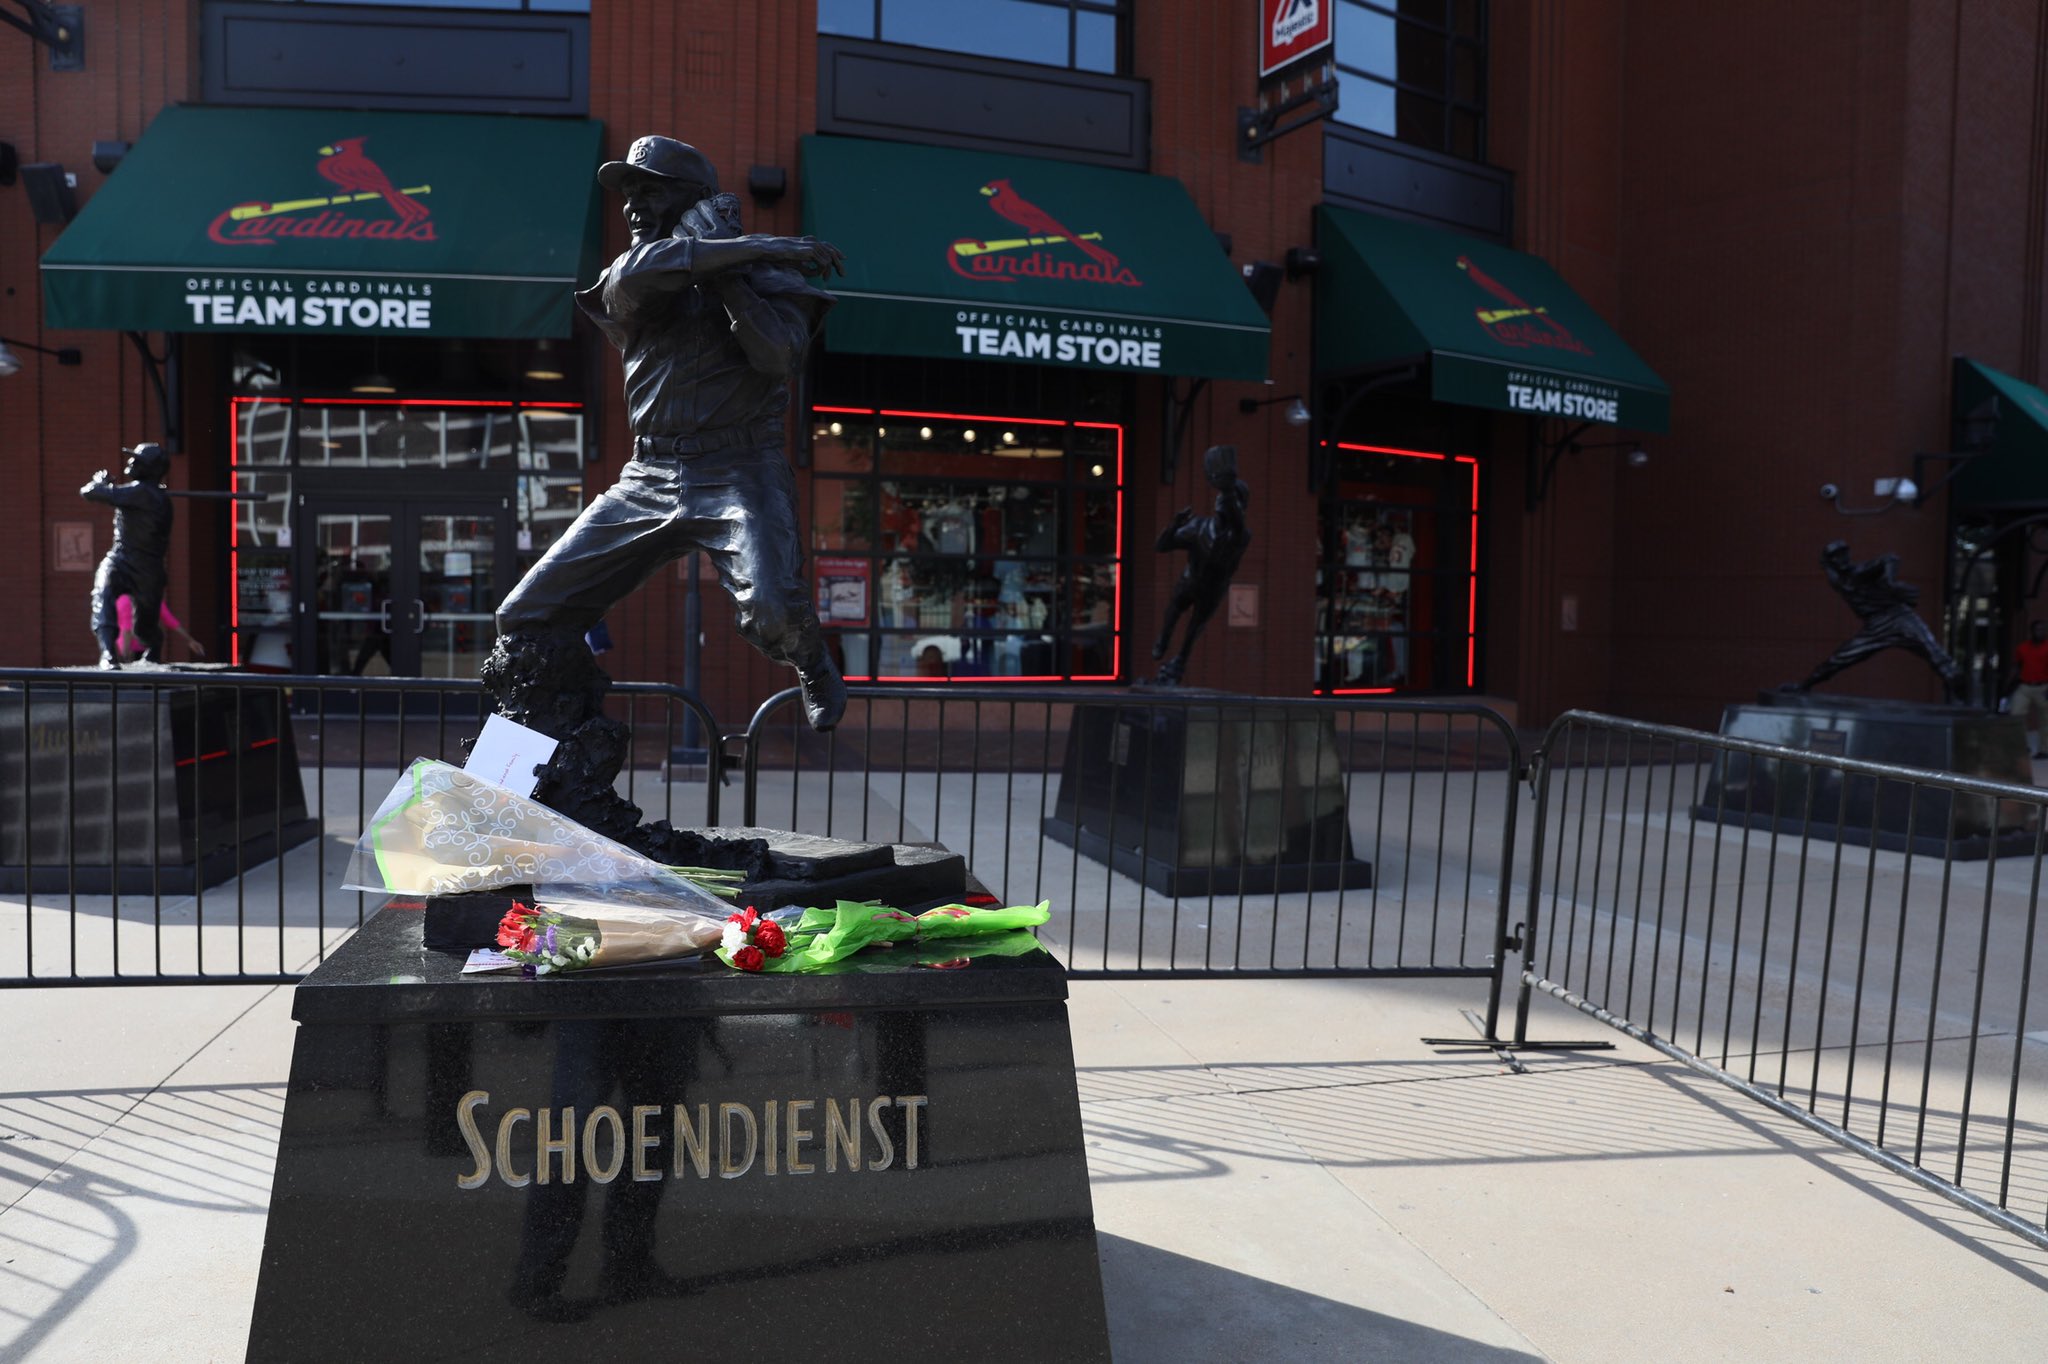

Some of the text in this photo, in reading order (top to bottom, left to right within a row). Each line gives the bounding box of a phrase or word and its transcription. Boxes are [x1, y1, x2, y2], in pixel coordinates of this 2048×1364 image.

[1275, 12, 1315, 37] Majestic
[207, 201, 438, 245] Cardinals
[946, 238, 1143, 287] Cardinals
[185, 278, 433, 296] OFFICIAL CARDINALS
[185, 294, 432, 329] TEAM STORE
[956, 311, 1163, 339] OFFICIAL CARDINALS
[956, 326, 1161, 368] TEAM STORE
[1507, 385, 1618, 422] TEAM STORE
[456, 1090, 928, 1190] SCHOENDIENST
